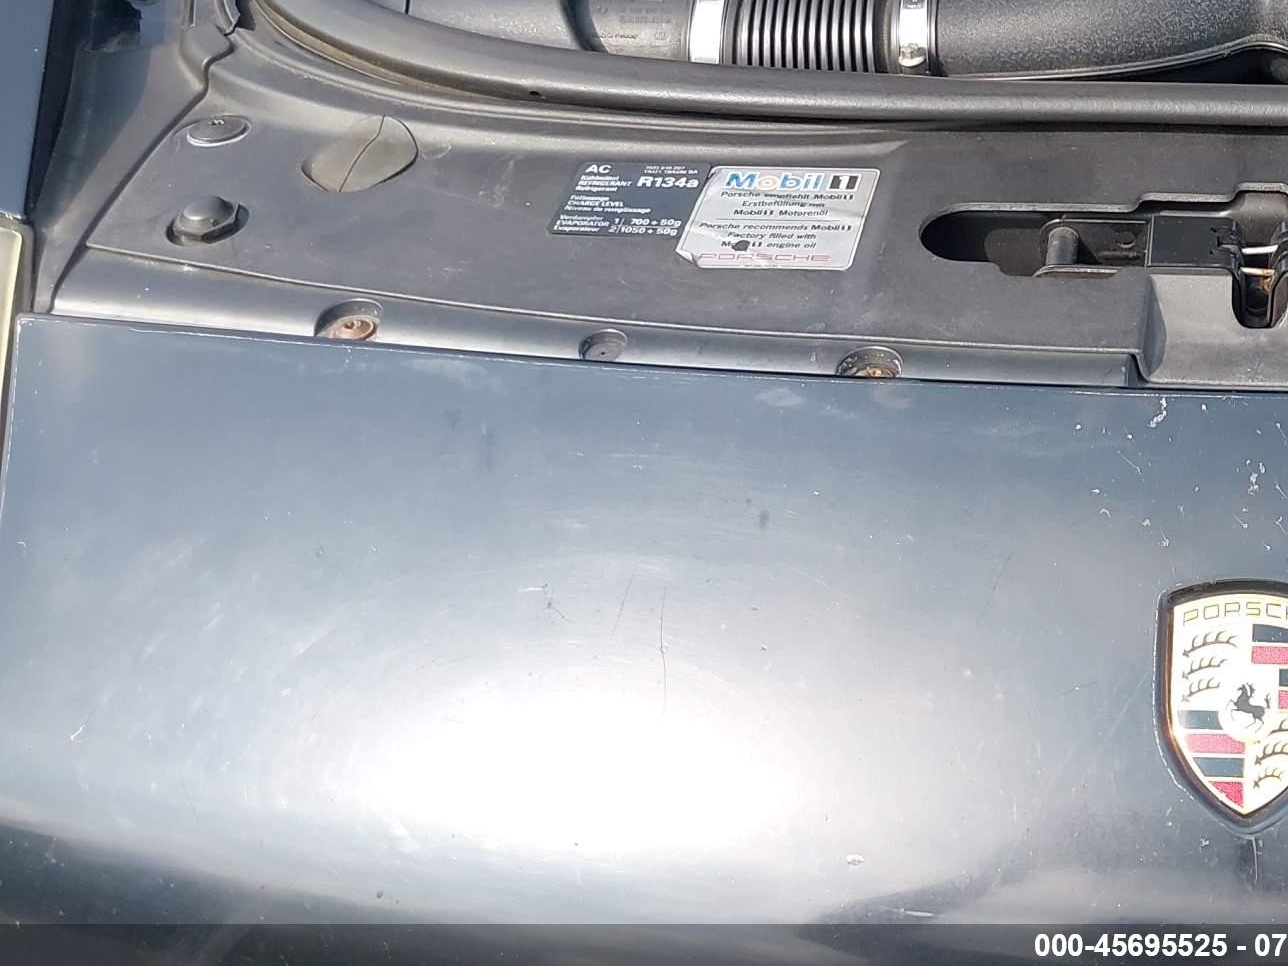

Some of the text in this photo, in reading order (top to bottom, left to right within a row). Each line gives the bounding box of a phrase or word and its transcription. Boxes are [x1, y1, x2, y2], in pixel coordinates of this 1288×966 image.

[585, 164, 612, 174] AC
[636, 176, 699, 189] R134a
[725, 172, 822, 189] Mobil
[660, 218, 682, 227] 50g
[699, 222, 740, 230] Porsche
[656, 227, 678, 236] 50g
[699, 253, 830, 262] PORSCHE
